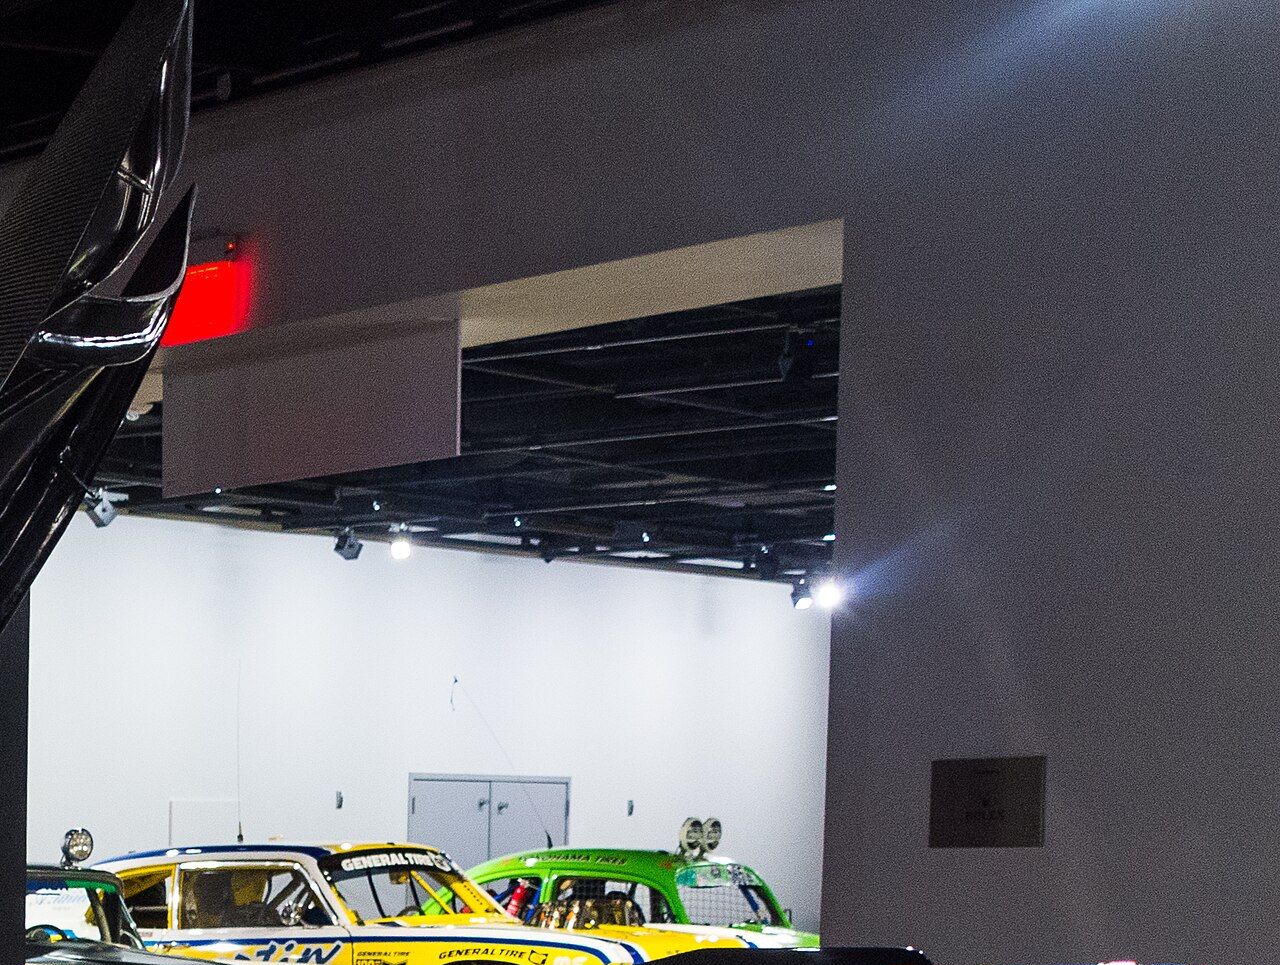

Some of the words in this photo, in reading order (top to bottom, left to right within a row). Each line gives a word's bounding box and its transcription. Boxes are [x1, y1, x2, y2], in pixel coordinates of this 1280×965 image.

[341, 853, 408, 871] GENERAL
[439, 948, 496, 960] GENERAL
[499, 948, 527, 959] TIRE
